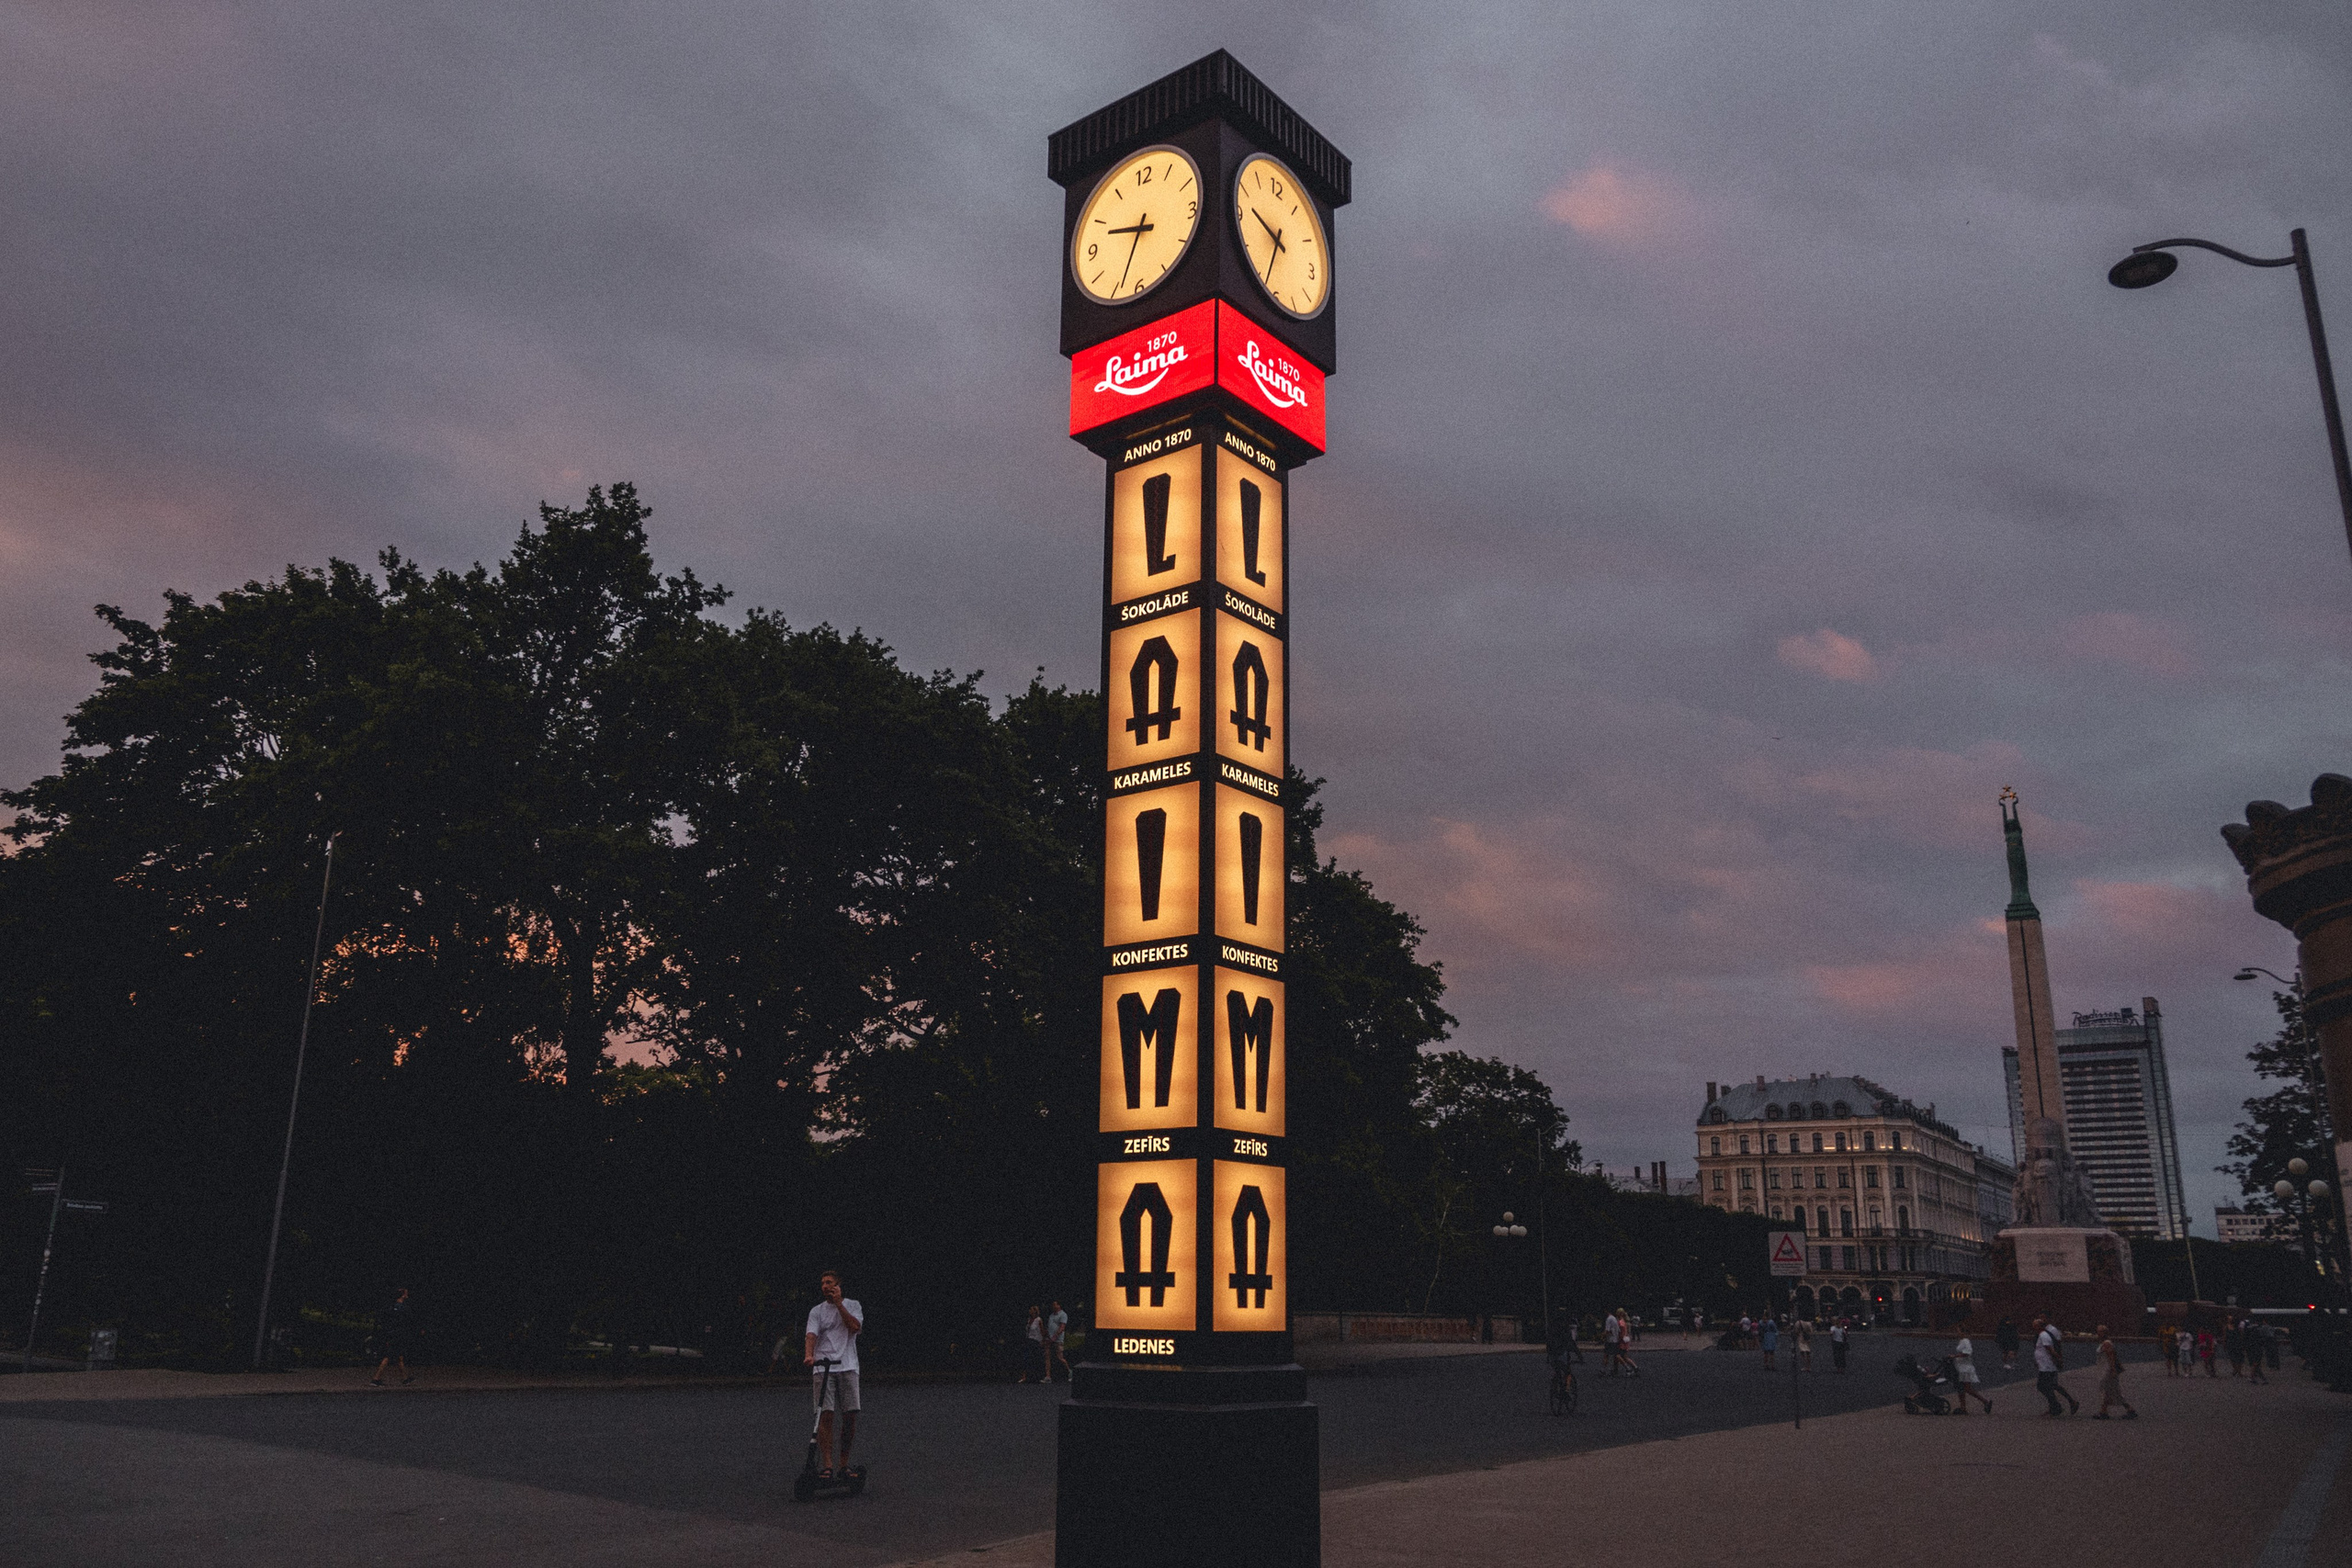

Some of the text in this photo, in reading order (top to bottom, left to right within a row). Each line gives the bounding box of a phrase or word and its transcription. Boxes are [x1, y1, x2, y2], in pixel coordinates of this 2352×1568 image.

[1136, 166, 1152, 186] 12
[1271, 175, 1285, 200] 12
[1187, 201, 1197, 220] 3
[1089, 243, 1098, 261] 9
[1308, 263, 1315, 280] 3
[1147, 331, 1178, 353] 1870
[1094, 342, 1188, 395] Laima
[1238, 341, 1307, 408] Laima
[1278, 357, 1300, 381] 1870
[1124, 428, 1192, 463] ANNO 1870
[1225, 432, 1276, 472] ANNO 1870
[1121, 591, 1189, 621] ŠOKOLĀDE
[1225, 592, 1276, 629] ŠOKOLĀDE
[1114, 761, 1192, 790] KARAMELES
[1222, 763, 1279, 797] KARAMELES
[1114, 944, 1188, 968] KONFEKTES
[1222, 945, 1279, 973] KONFEKTES
[1125, 1136, 1170, 1153] ZEFĪRS
[1234, 1139, 1267, 1156] ZEFĪRS
[1114, 1338, 1174, 1354] LEDENES
